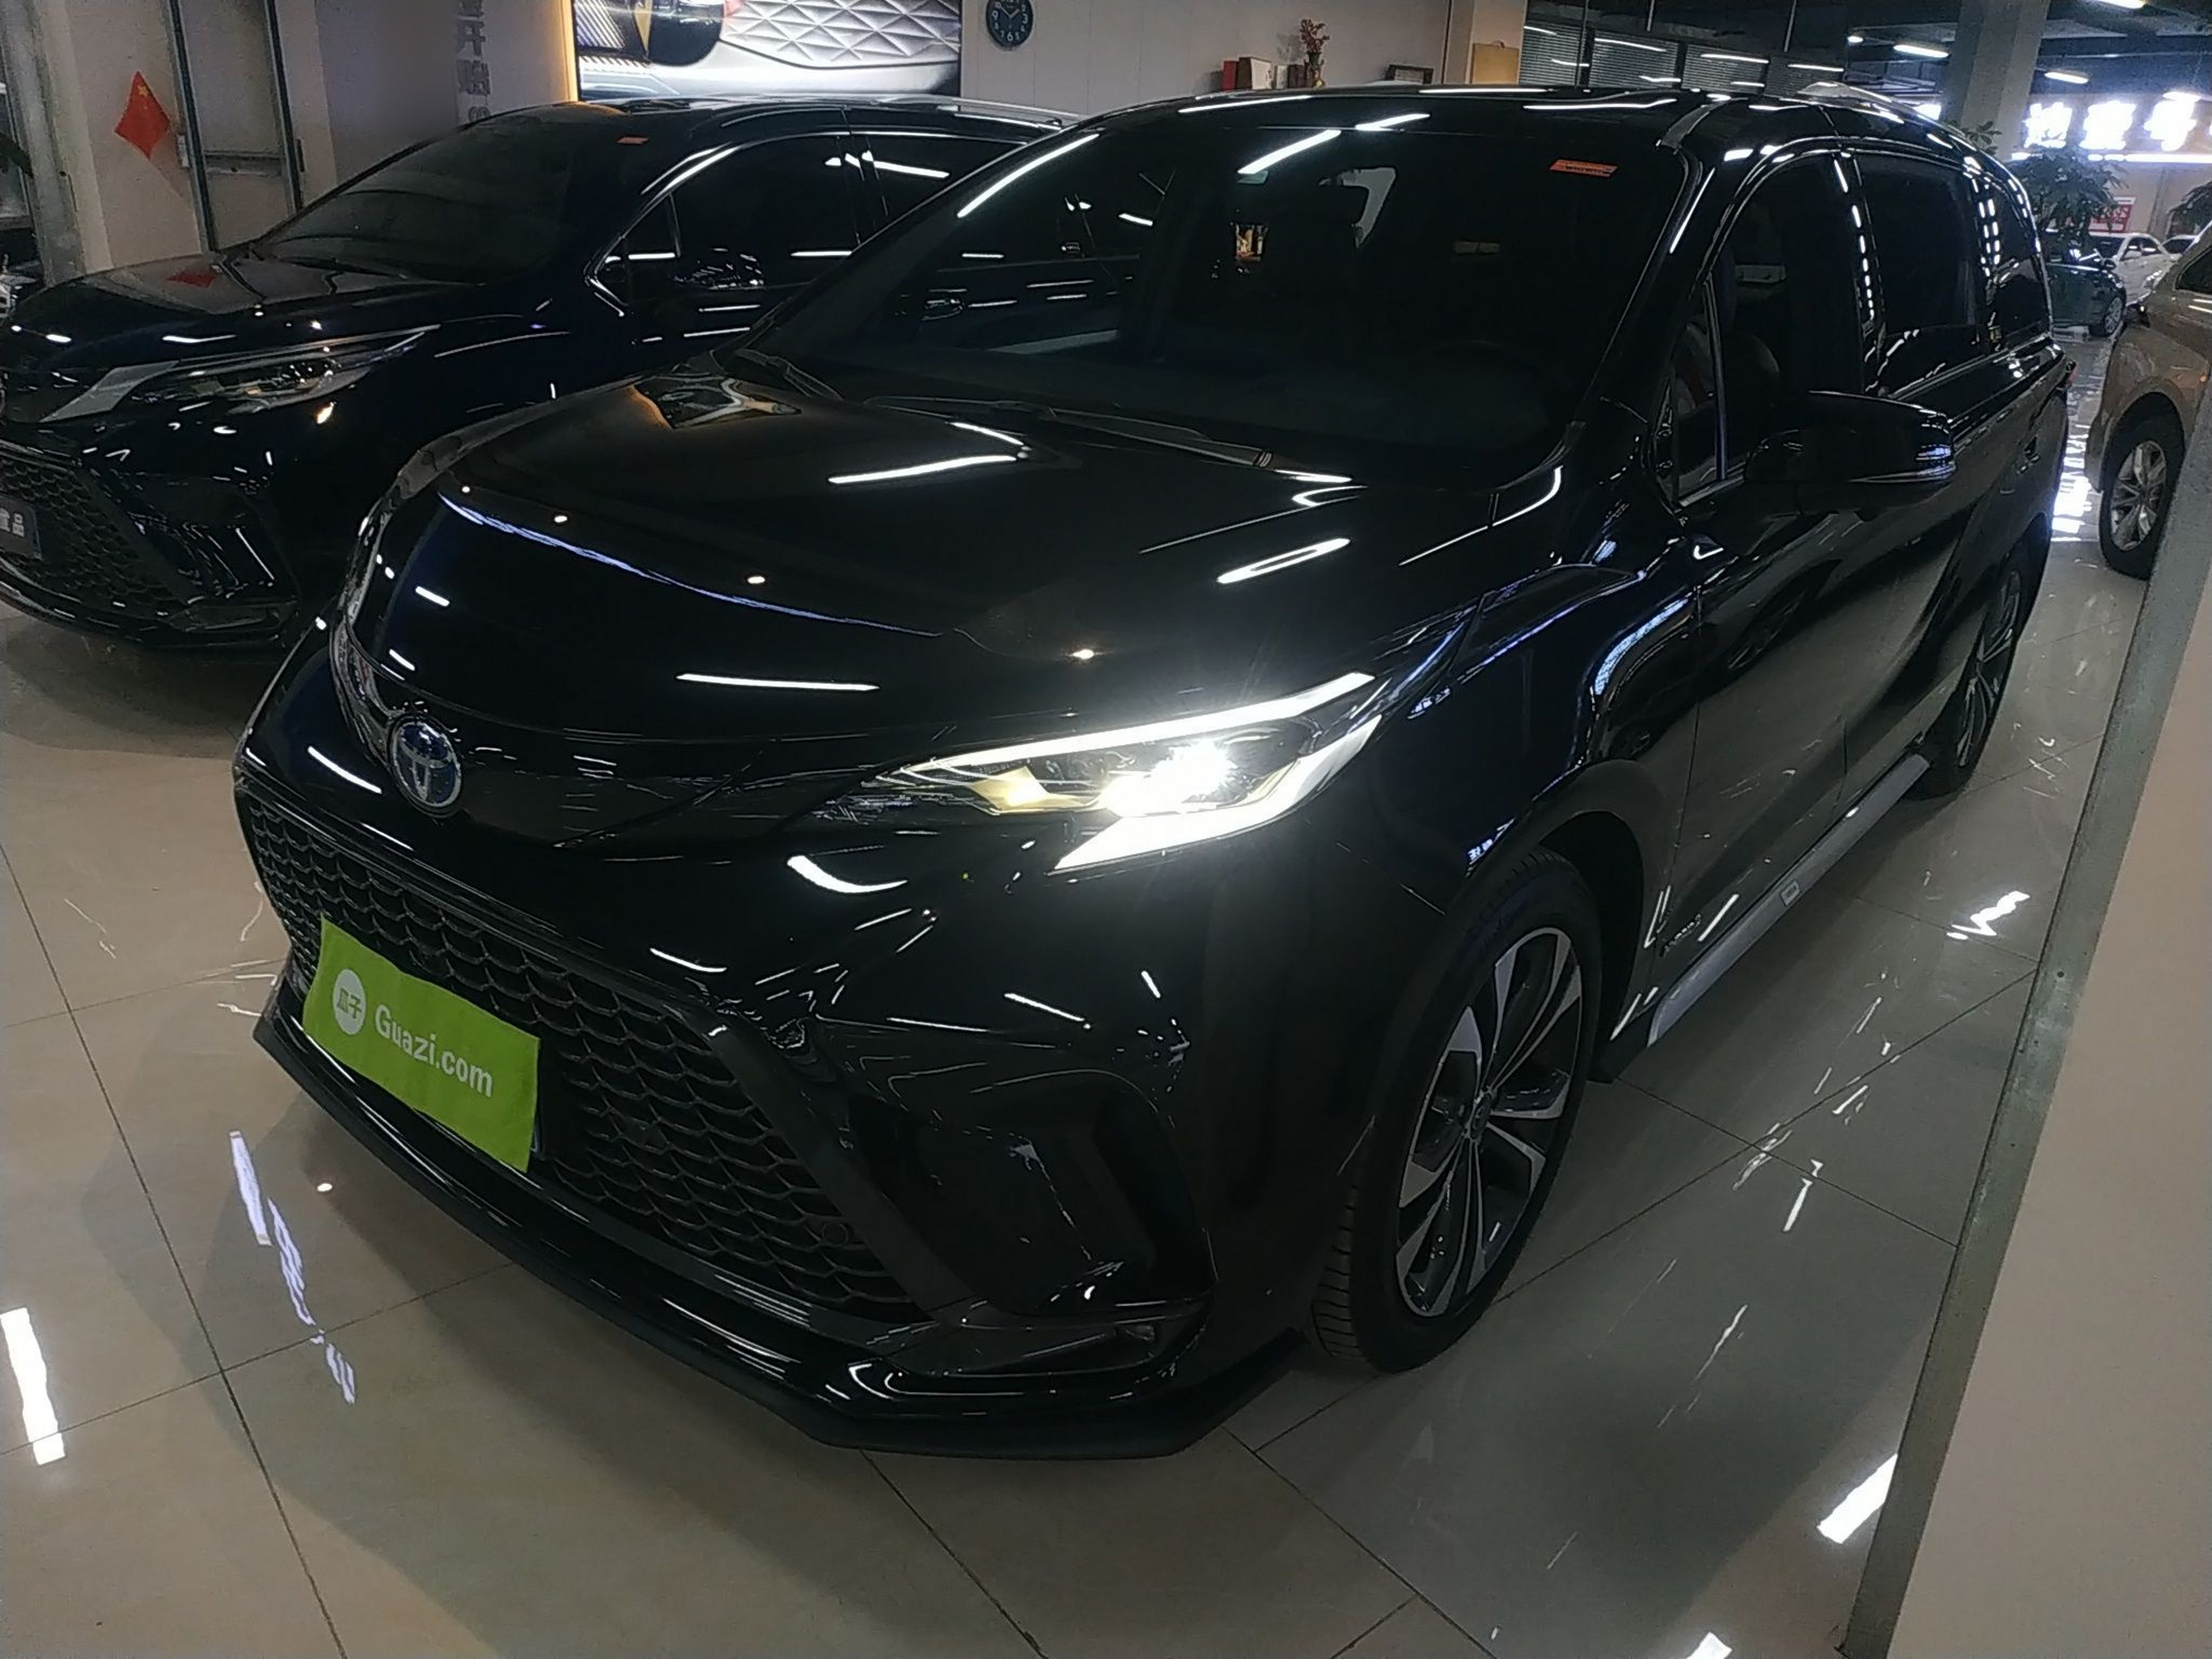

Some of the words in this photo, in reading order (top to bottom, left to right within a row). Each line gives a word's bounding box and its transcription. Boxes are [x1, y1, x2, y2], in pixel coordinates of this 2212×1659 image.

[1022, 13, 1028, 24] 3
[1007, 31, 1013, 41] 6
[374, 1003, 494, 1099] Guazi.com
